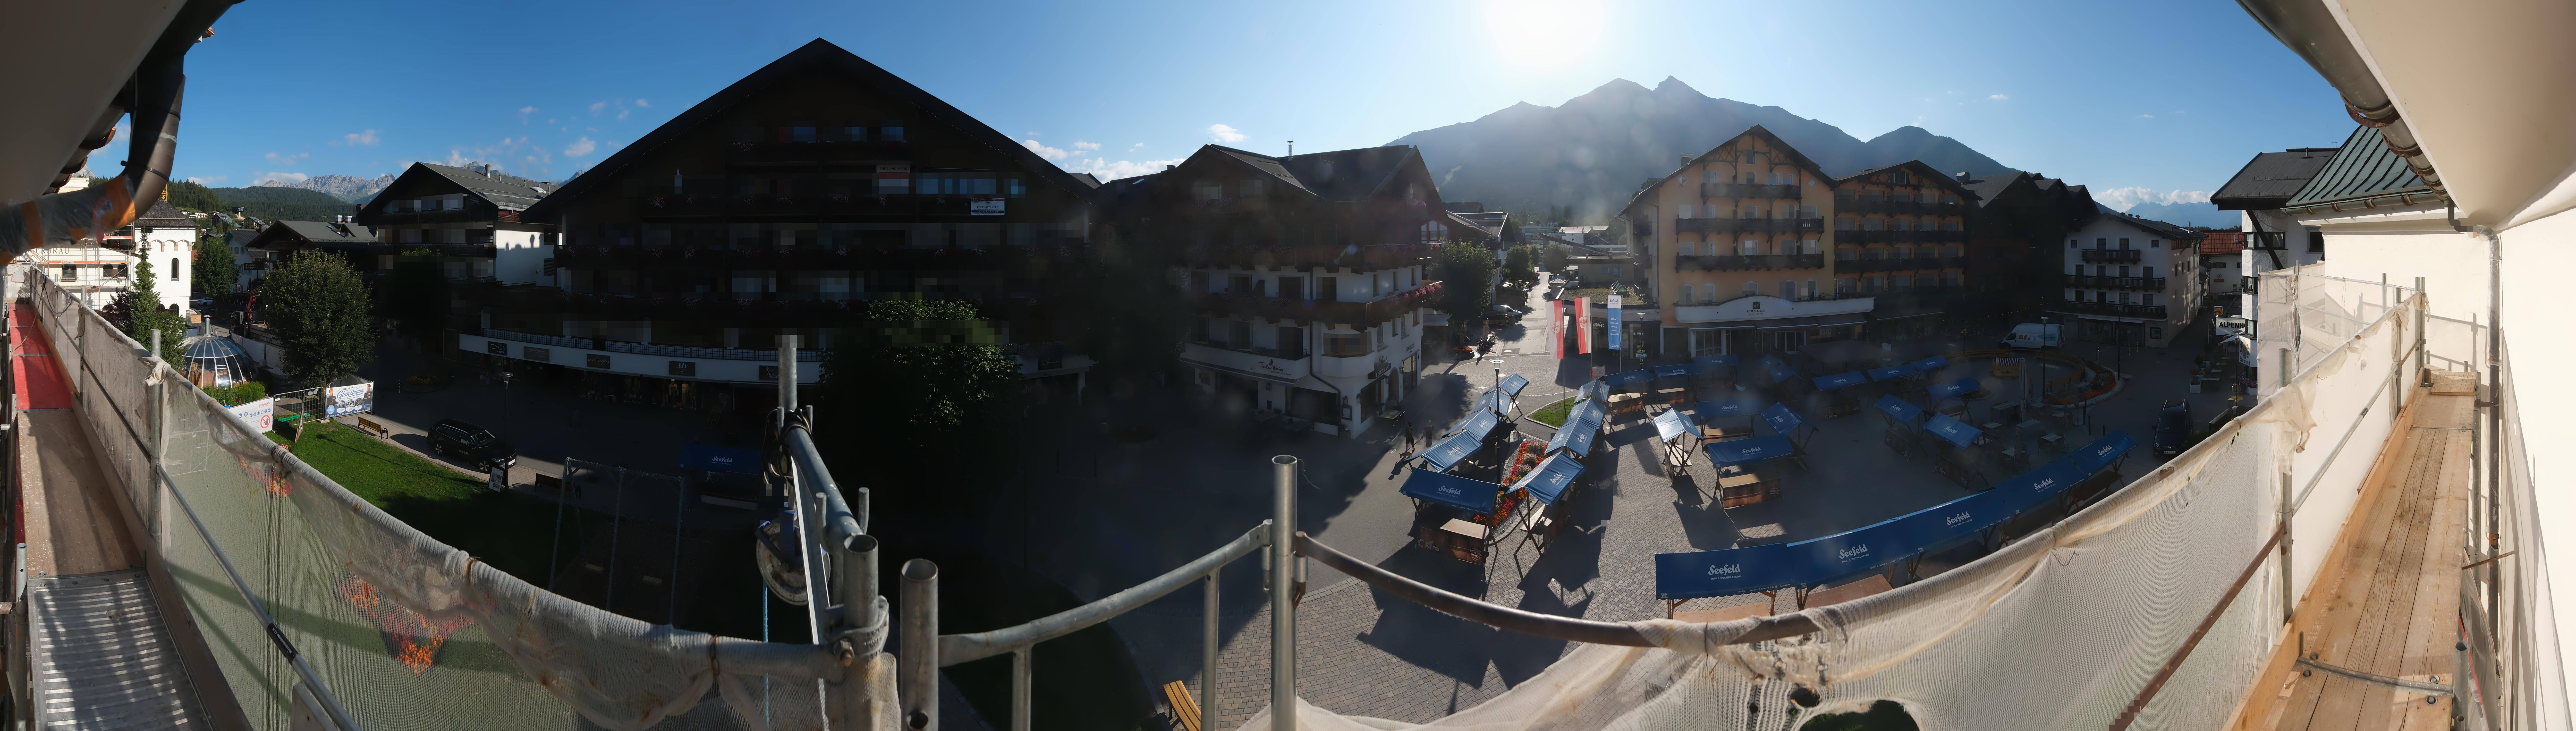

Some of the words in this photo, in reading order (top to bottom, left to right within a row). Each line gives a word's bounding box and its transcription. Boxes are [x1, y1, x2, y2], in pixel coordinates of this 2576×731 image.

[1376, 365, 1390, 377] RESTAURANT
[337, 388, 364, 401] Glanzbuam
[1447, 445, 1461, 455] Seefeld
[2098, 445, 2112, 455] Seefeld
[1550, 472, 1562, 484] Seefeld
[2034, 478, 2053, 490] Seefeld
[1438, 485, 1461, 495] Seefeld
[1946, 511, 1970, 525] Seefeld
[1839, 543, 1868, 559] Seefeld
[1708, 563, 1741, 575] Seefeld
